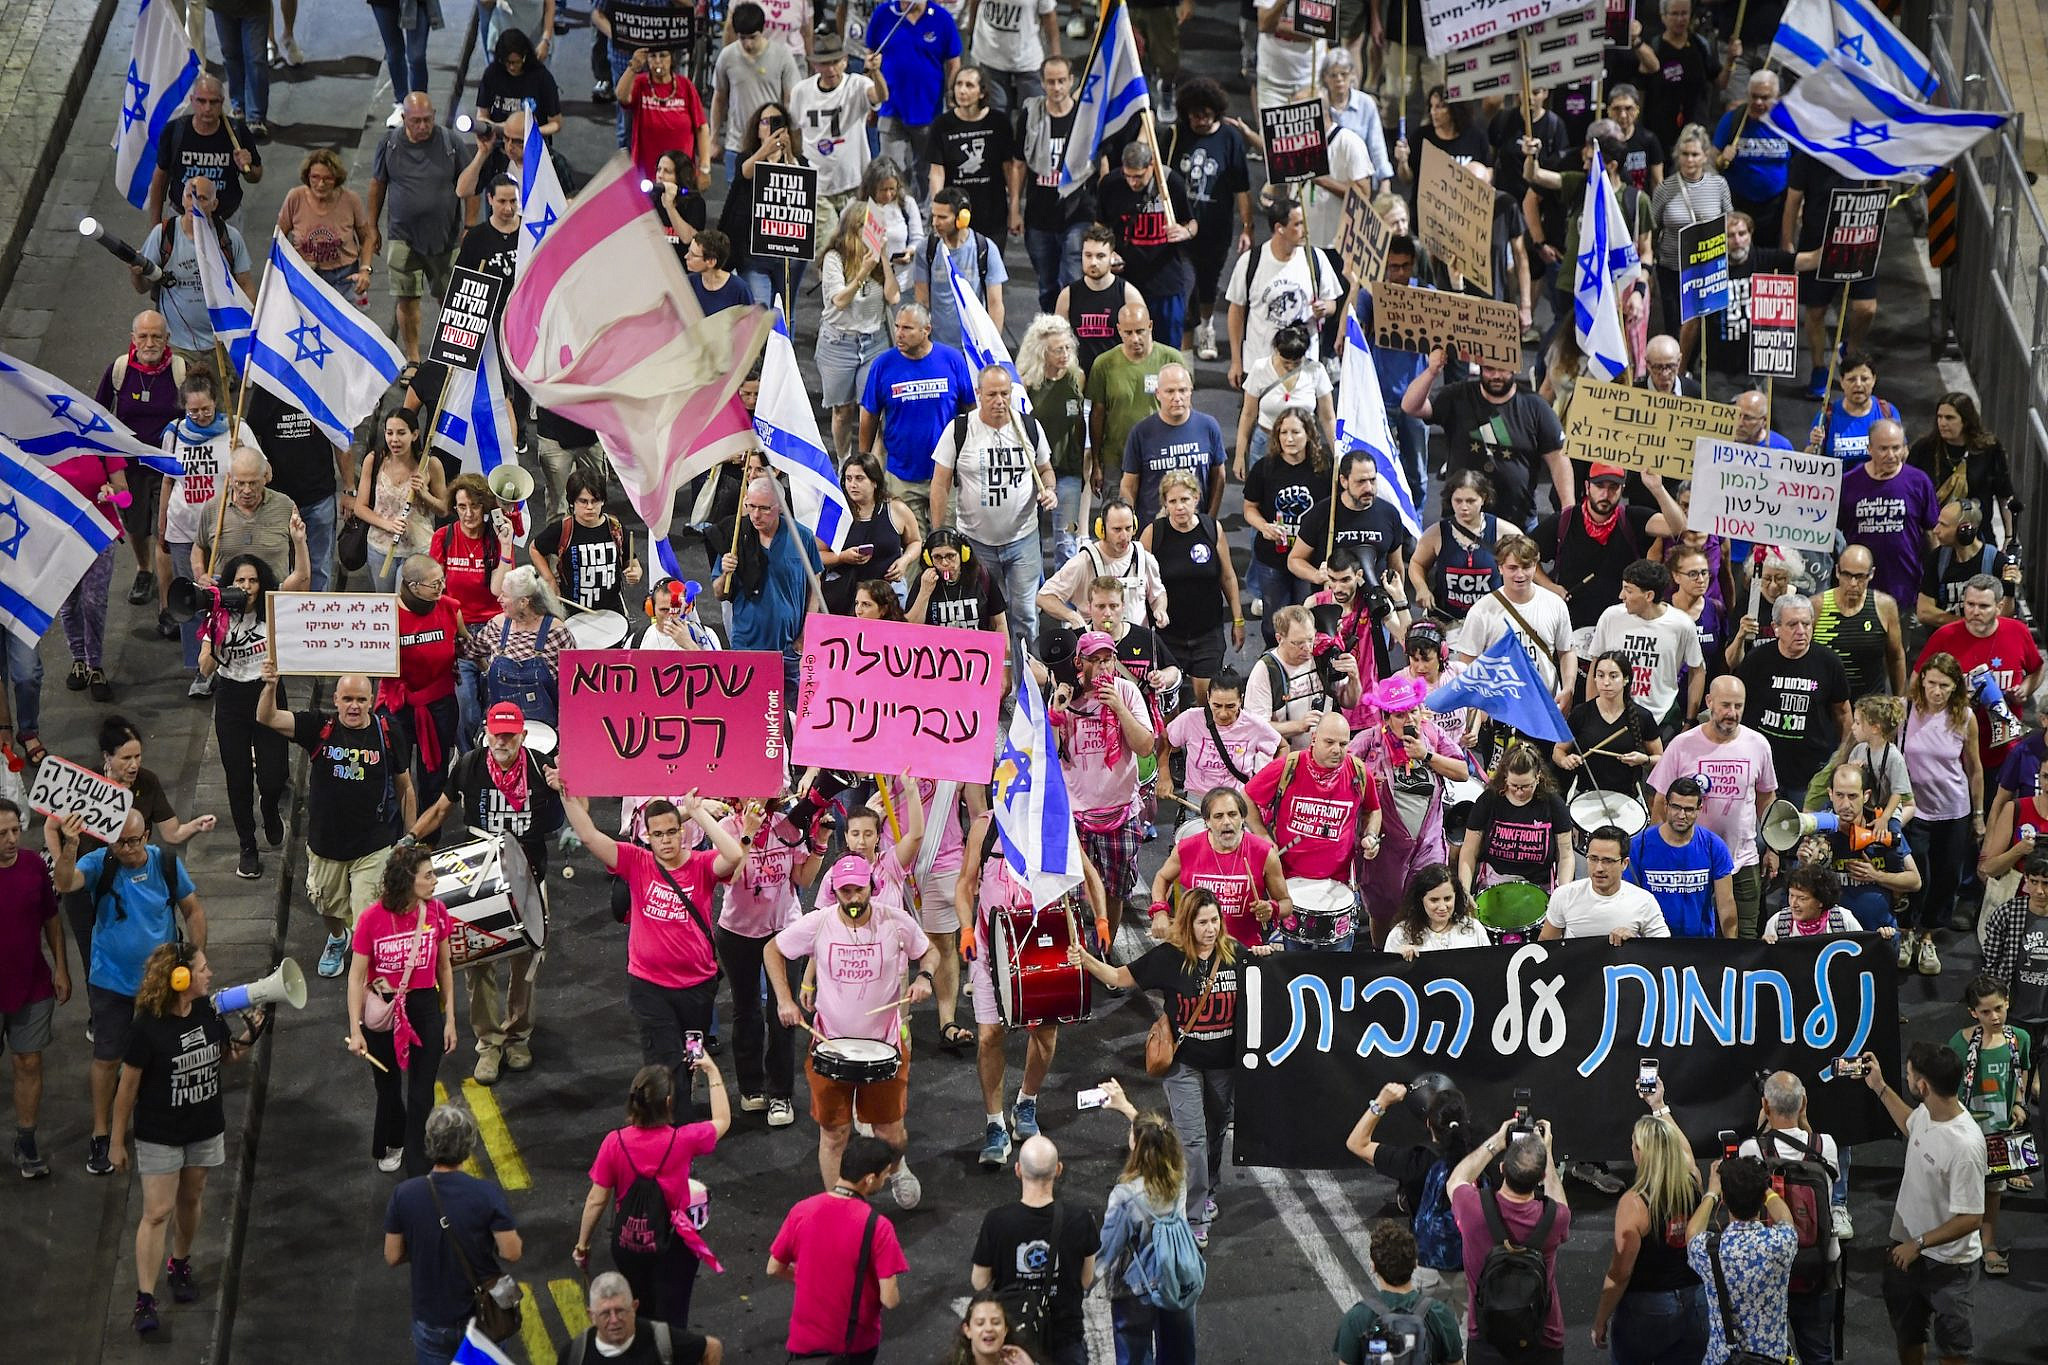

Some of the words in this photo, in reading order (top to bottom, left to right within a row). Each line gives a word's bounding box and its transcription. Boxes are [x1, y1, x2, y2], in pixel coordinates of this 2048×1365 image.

[615, 11, 670, 27] דמוקרטיה
[674, 16, 689, 27] אין
[629, 28, 665, 39] כיבוש
[670, 29, 689, 38] עם
[1447, 20, 1496, 43] הסוגני
[1265, 103, 1320, 126] ממשלת
[1274, 120, 1315, 138] הטבח
[182, 151, 230, 166] נאמנים
[769, 172, 804, 190] ועדת
[763, 187, 807, 206] חקירה
[1834, 193, 1886, 212] ממשלת
[755, 203, 813, 224] ממלכתית
[1840, 210, 1878, 227] הטבח
[761, 219, 806, 240] עכשיו!
[460, 278, 490, 299] ועדת
[452, 292, 488, 315] חקירה
[1754, 297, 1795, 320] הביטחון
[441, 308, 488, 335] ממלכתית
[442, 325, 478, 349] עכשיו!
[1753, 349, 1794, 372] בשלטון
[1581, 385, 1630, 401] מאשר
[1614, 407, 1657, 426] שם
[1711, 404, 1737, 421] אם
[1571, 417, 1593, 437] לא
[183, 446, 213, 461] אתה
[987, 447, 1024, 467] דמו
[1169, 442, 1200, 457] ביטחון
[1712, 444, 1772, 469] באייפון
[1149, 457, 1176, 470] שווה
[1179, 452, 1209, 468] שירות
[1780, 456, 1836, 477] מעשה
[184, 475, 214, 489] אתה
[988, 467, 1025, 488] קרט
[1720, 470, 1769, 491] להמון
[184, 489, 215, 504] אשם
[989, 487, 1008, 507] יה
[1777, 480, 1835, 502] המוצג
[1725, 496, 1781, 516] שלטון
[1856, 506, 1888, 517] שלום
[1890, 506, 1906, 518] רק
[1715, 514, 1755, 538] אסון
[1764, 522, 1831, 545] שמסתיר
[579, 542, 617, 567] דמו
[580, 564, 616, 590] קרט
[1445, 573, 1492, 592] FCK
[580, 587, 600, 608] יה
[297, 600, 316, 614] לא,
[322, 601, 340, 614] לא,
[346, 601, 365, 615] לא,
[370, 601, 389, 615] לא,
[938, 598, 978, 622] דמו
[305, 620, 345, 632] ישתיקו
[350, 619, 366, 631] לא
[372, 621, 390, 631] הם
[302, 638, 328, 648] מהר
[360, 639, 390, 649] אותנו
[416, 631, 444, 644] דרושה:
[1624, 634, 1657, 651] אתה
[821, 632, 992, 688] הממשלה
[570, 661, 636, 695] הוא
[650, 662, 755, 710] שקט
[812, 696, 980, 744] עבריינית
[1707, 764, 1743, 776] התקווה
[1711, 776, 1736, 785] תמיד
[1295, 801, 1345, 819] PINKFRONT
[1495, 827, 1544, 843] PINKFRONT
[1646, 873, 1709, 884] הדמוקרטים
[838, 948, 875, 959] התקווה
[841, 959, 868, 968] תמיד
[836, 968, 873, 979] מנצחת
[1491, 941, 1567, 1059] על
[1242, 965, 1475, 1070] הבית!
